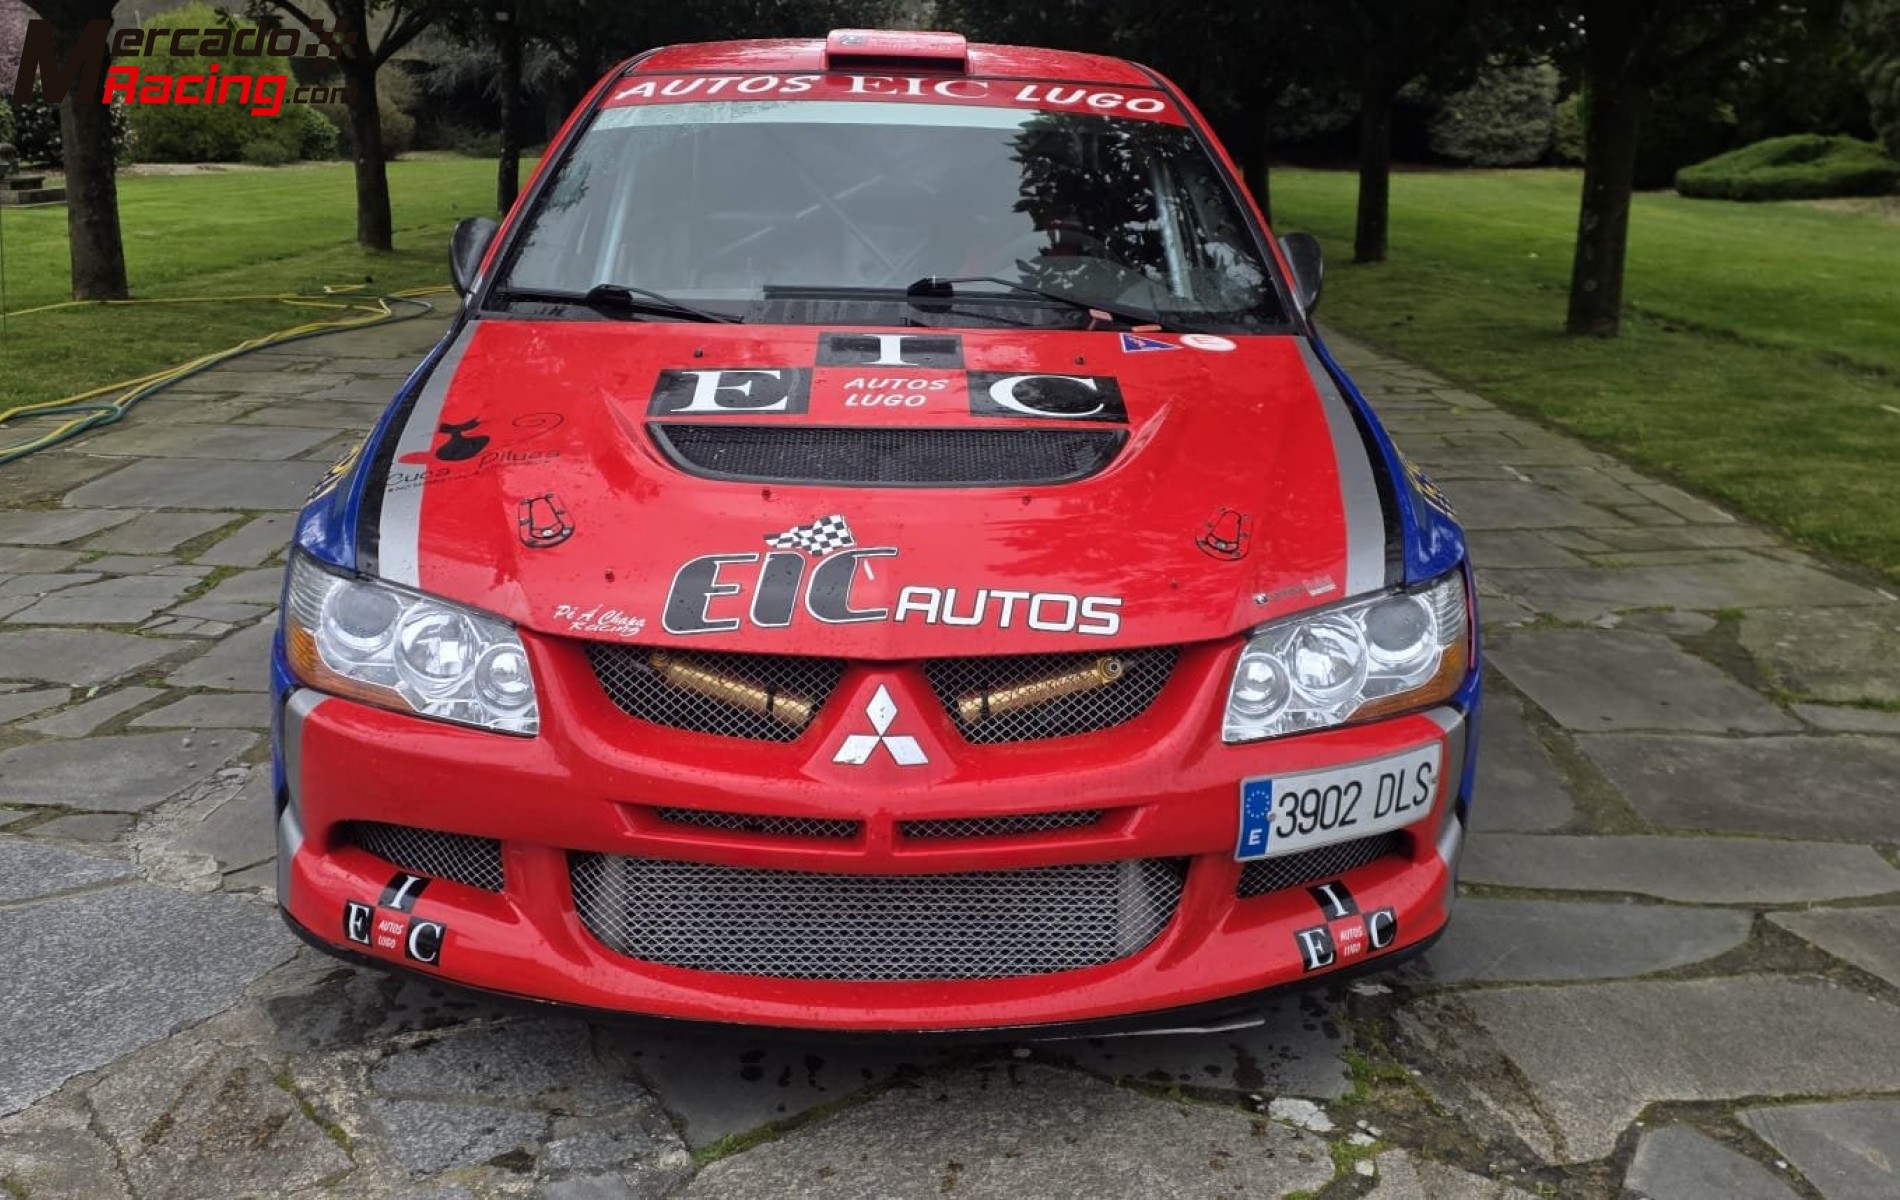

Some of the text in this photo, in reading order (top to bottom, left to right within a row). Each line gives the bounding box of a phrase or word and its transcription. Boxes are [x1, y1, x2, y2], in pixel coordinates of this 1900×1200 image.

[614, 74, 1166, 114] AUTOS EIC LUGO
[843, 378, 950, 391] AUTOS
[844, 394, 927, 408] LUGO
[661, 547, 1123, 637] EIC AUTOS
[1275, 761, 1433, 839] 3902 DLS
[1248, 828, 1263, 846] E
[378, 919, 404, 935] AUTOS
